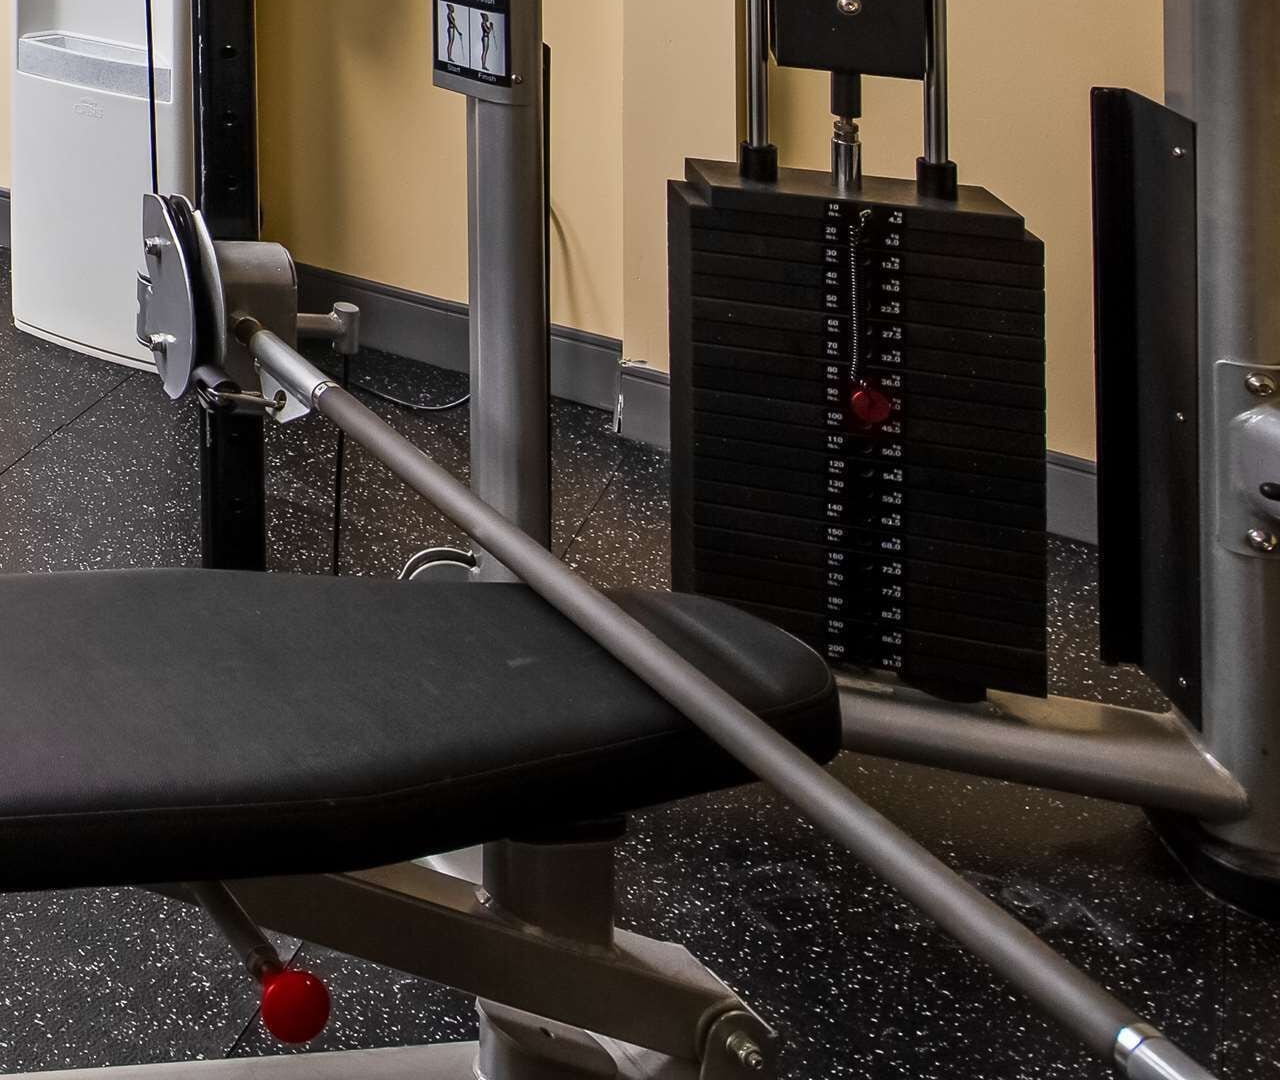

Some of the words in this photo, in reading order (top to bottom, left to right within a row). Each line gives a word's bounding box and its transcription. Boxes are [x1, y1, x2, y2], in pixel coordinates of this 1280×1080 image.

[827, 412, 843, 420] 100
[829, 460, 844, 468] 120
[829, 480, 844, 488] 130
[828, 644, 844, 652] 200
